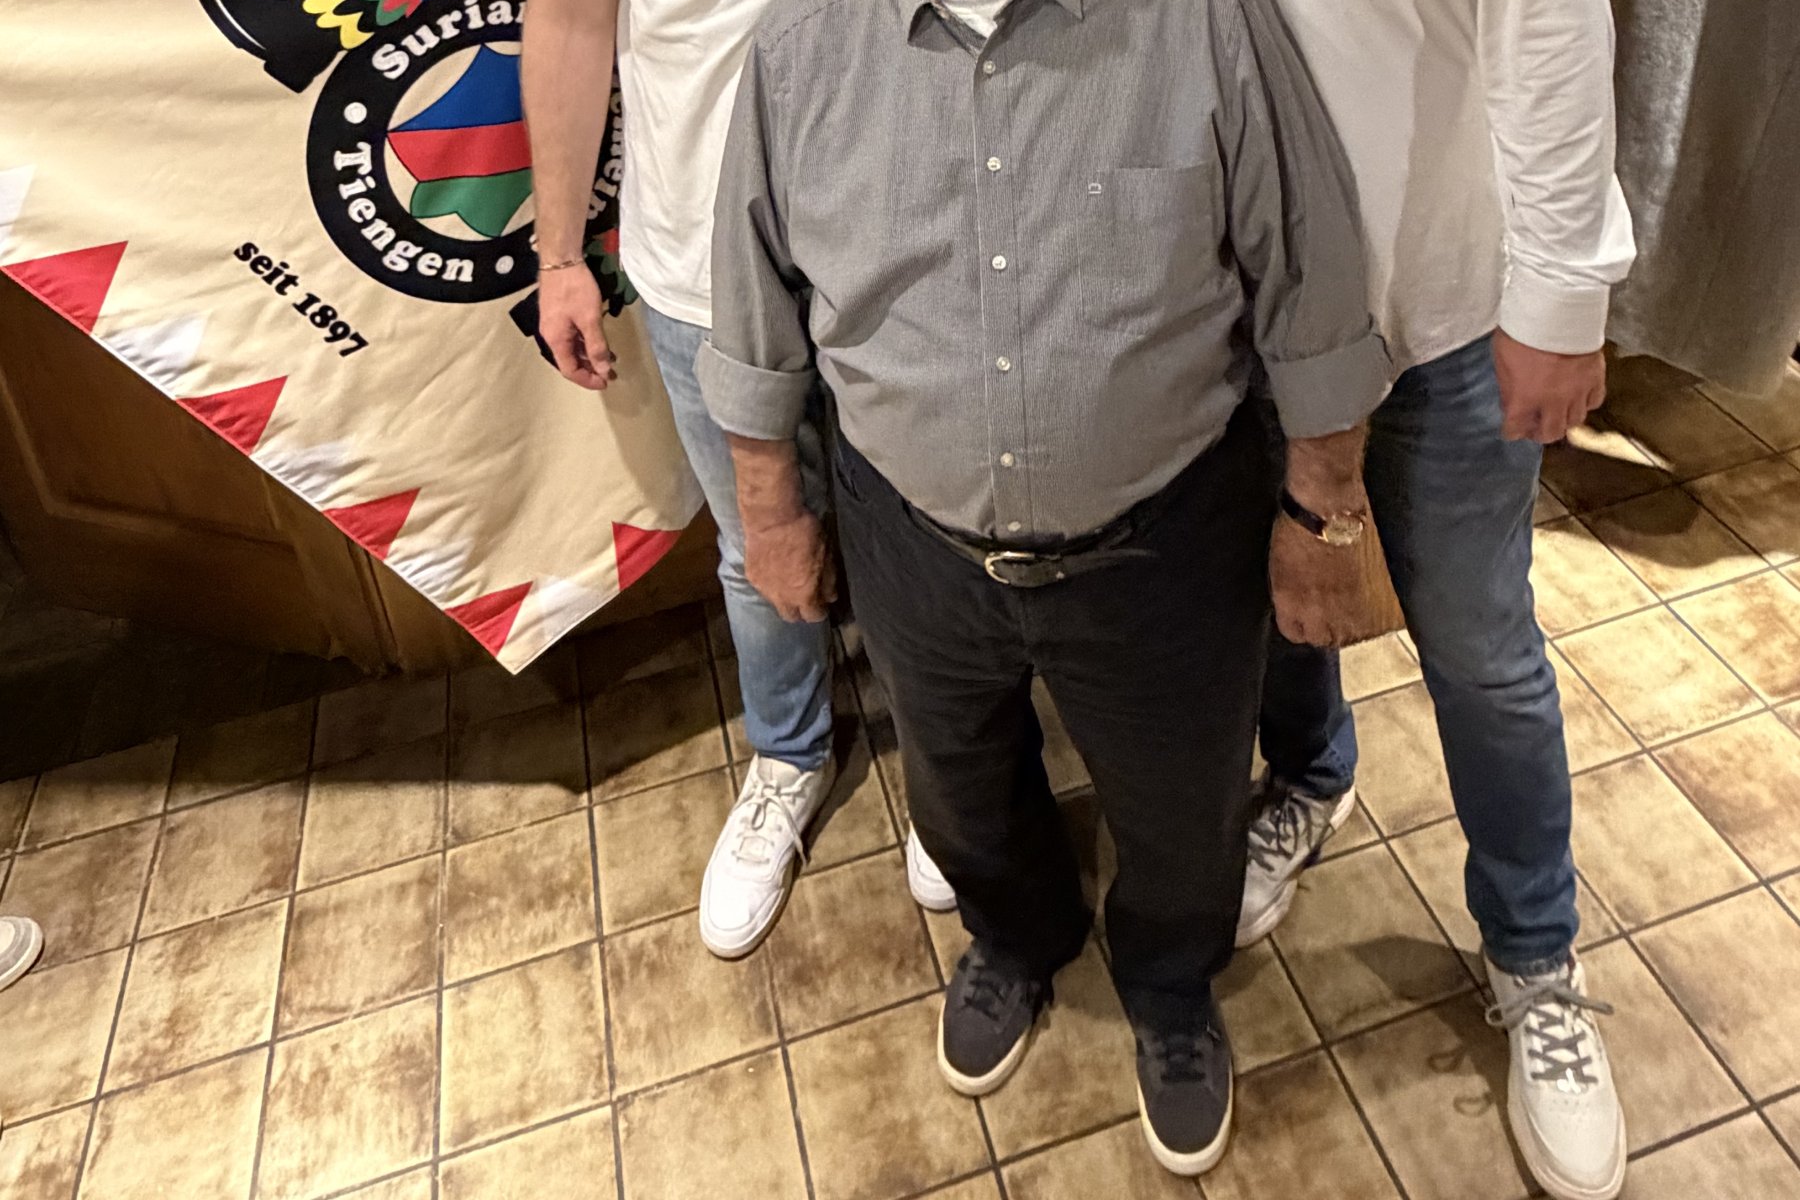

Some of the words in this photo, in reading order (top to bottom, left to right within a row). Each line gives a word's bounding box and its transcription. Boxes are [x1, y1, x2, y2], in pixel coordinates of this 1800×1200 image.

[333, 141, 474, 283] Tiengen
[233, 242, 299, 296] seit
[292, 292, 369, 357] 1897
